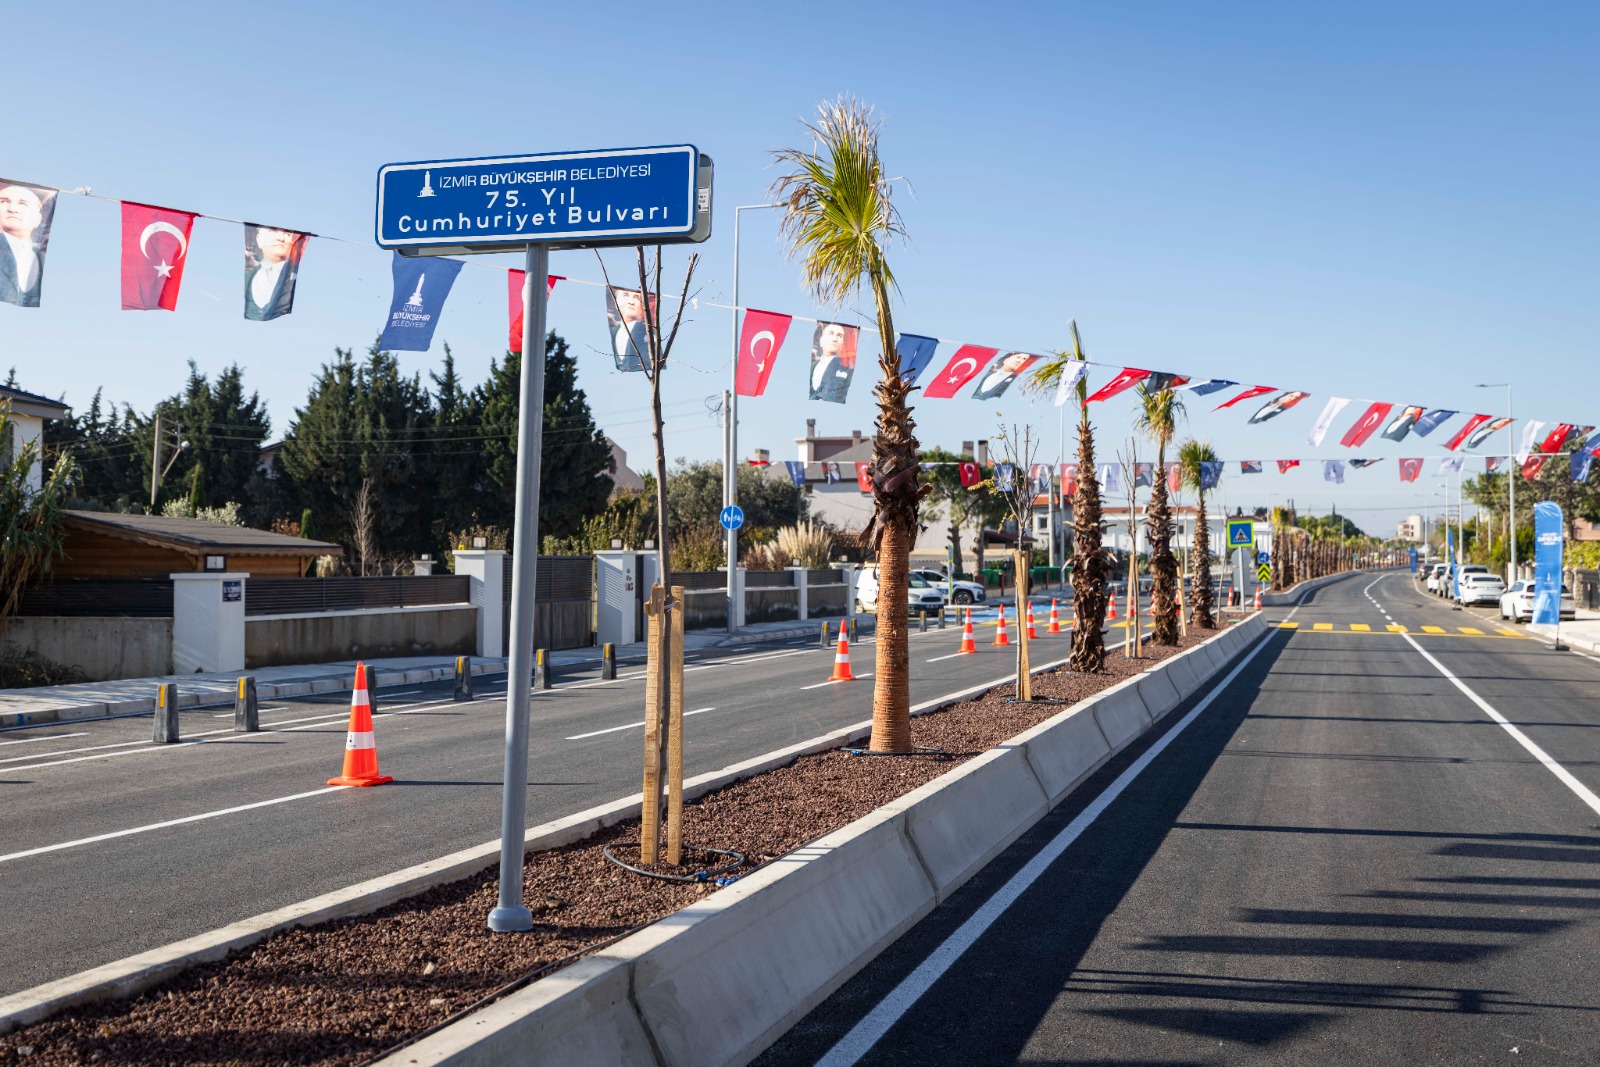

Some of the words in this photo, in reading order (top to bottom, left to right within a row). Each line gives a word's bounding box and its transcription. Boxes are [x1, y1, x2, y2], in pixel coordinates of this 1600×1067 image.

[439, 175, 477, 188] İZMİR
[480, 170, 567, 186] BÜYÜKŞEHİR
[570, 163, 651, 181] BELEDİYESİ
[485, 190, 526, 209] 75.
[540, 187, 575, 206] Yıl
[398, 208, 557, 233] Cumhuriyet
[567, 204, 669, 225] Bulvarı
